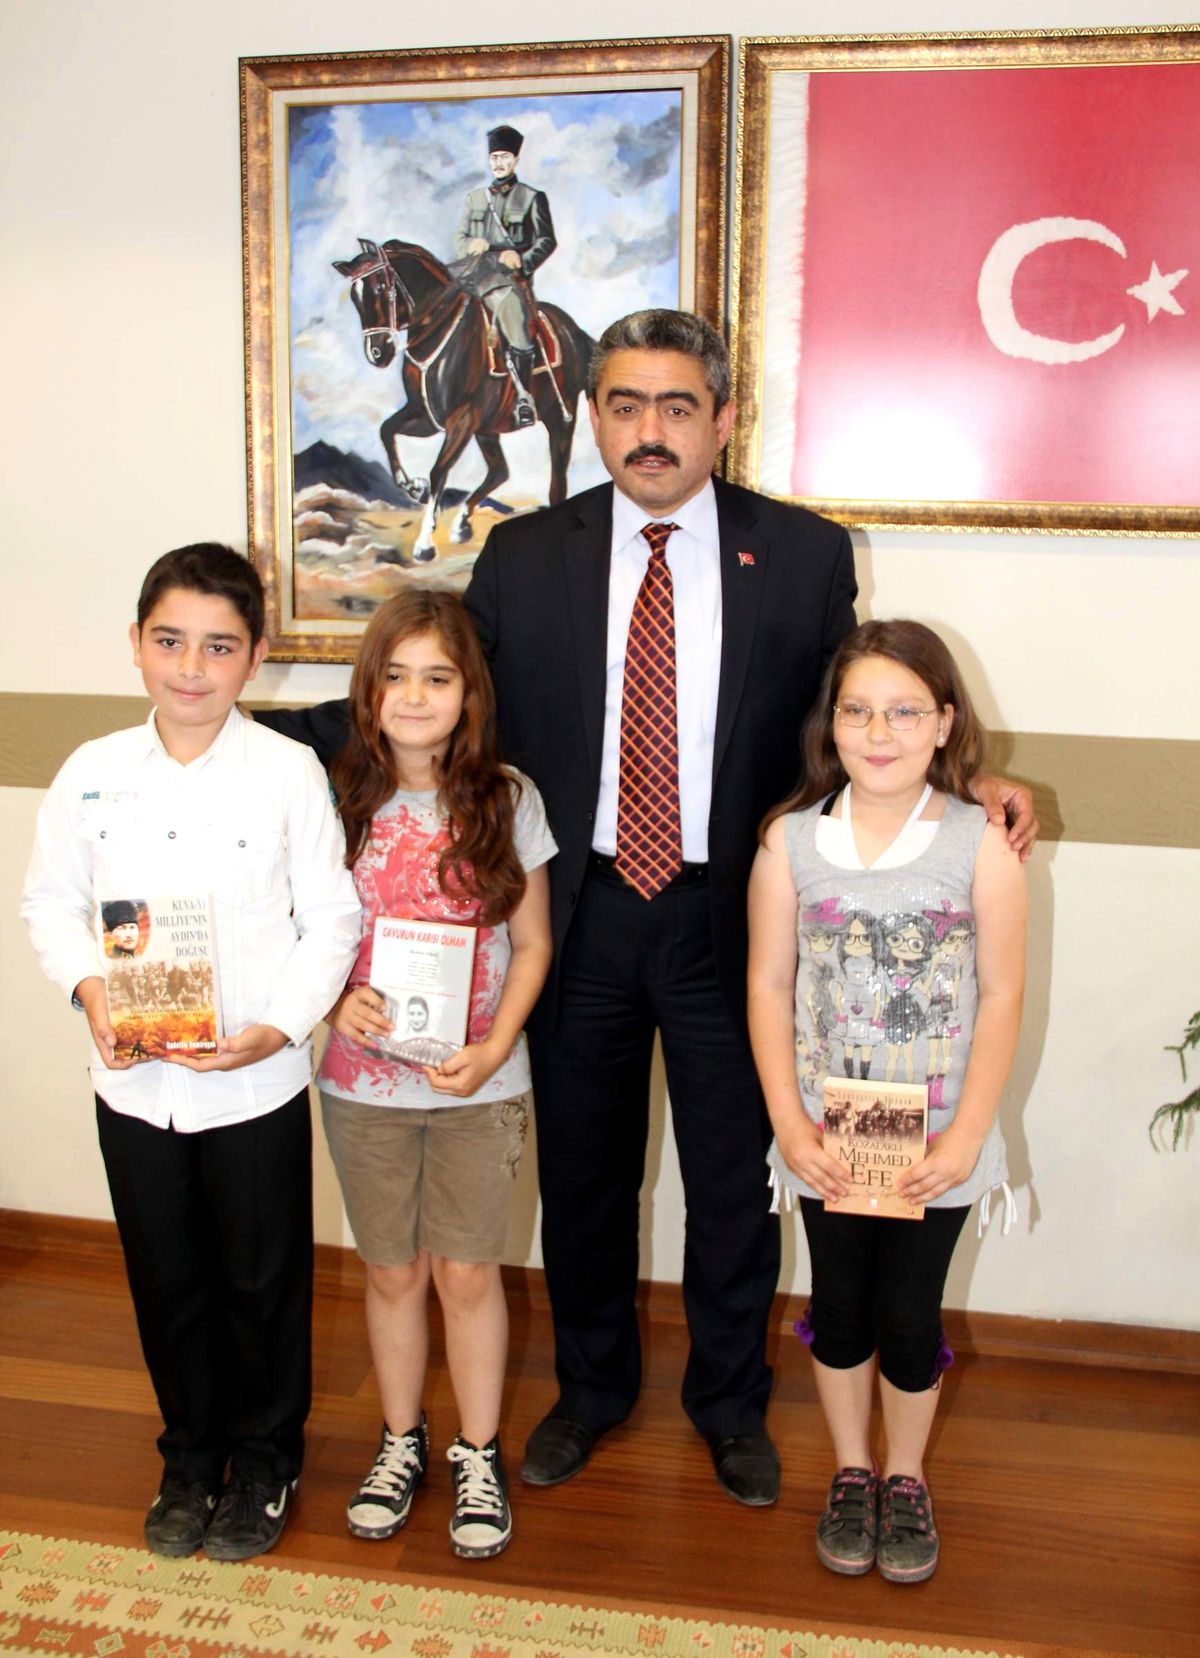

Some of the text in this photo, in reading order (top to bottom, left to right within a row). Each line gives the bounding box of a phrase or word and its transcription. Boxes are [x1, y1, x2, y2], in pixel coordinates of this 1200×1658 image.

[848, 1138, 902, 1151] KOZALAKLI
[839, 1146, 912, 1167] MEHMED
[850, 1162, 893, 1188] EFE
